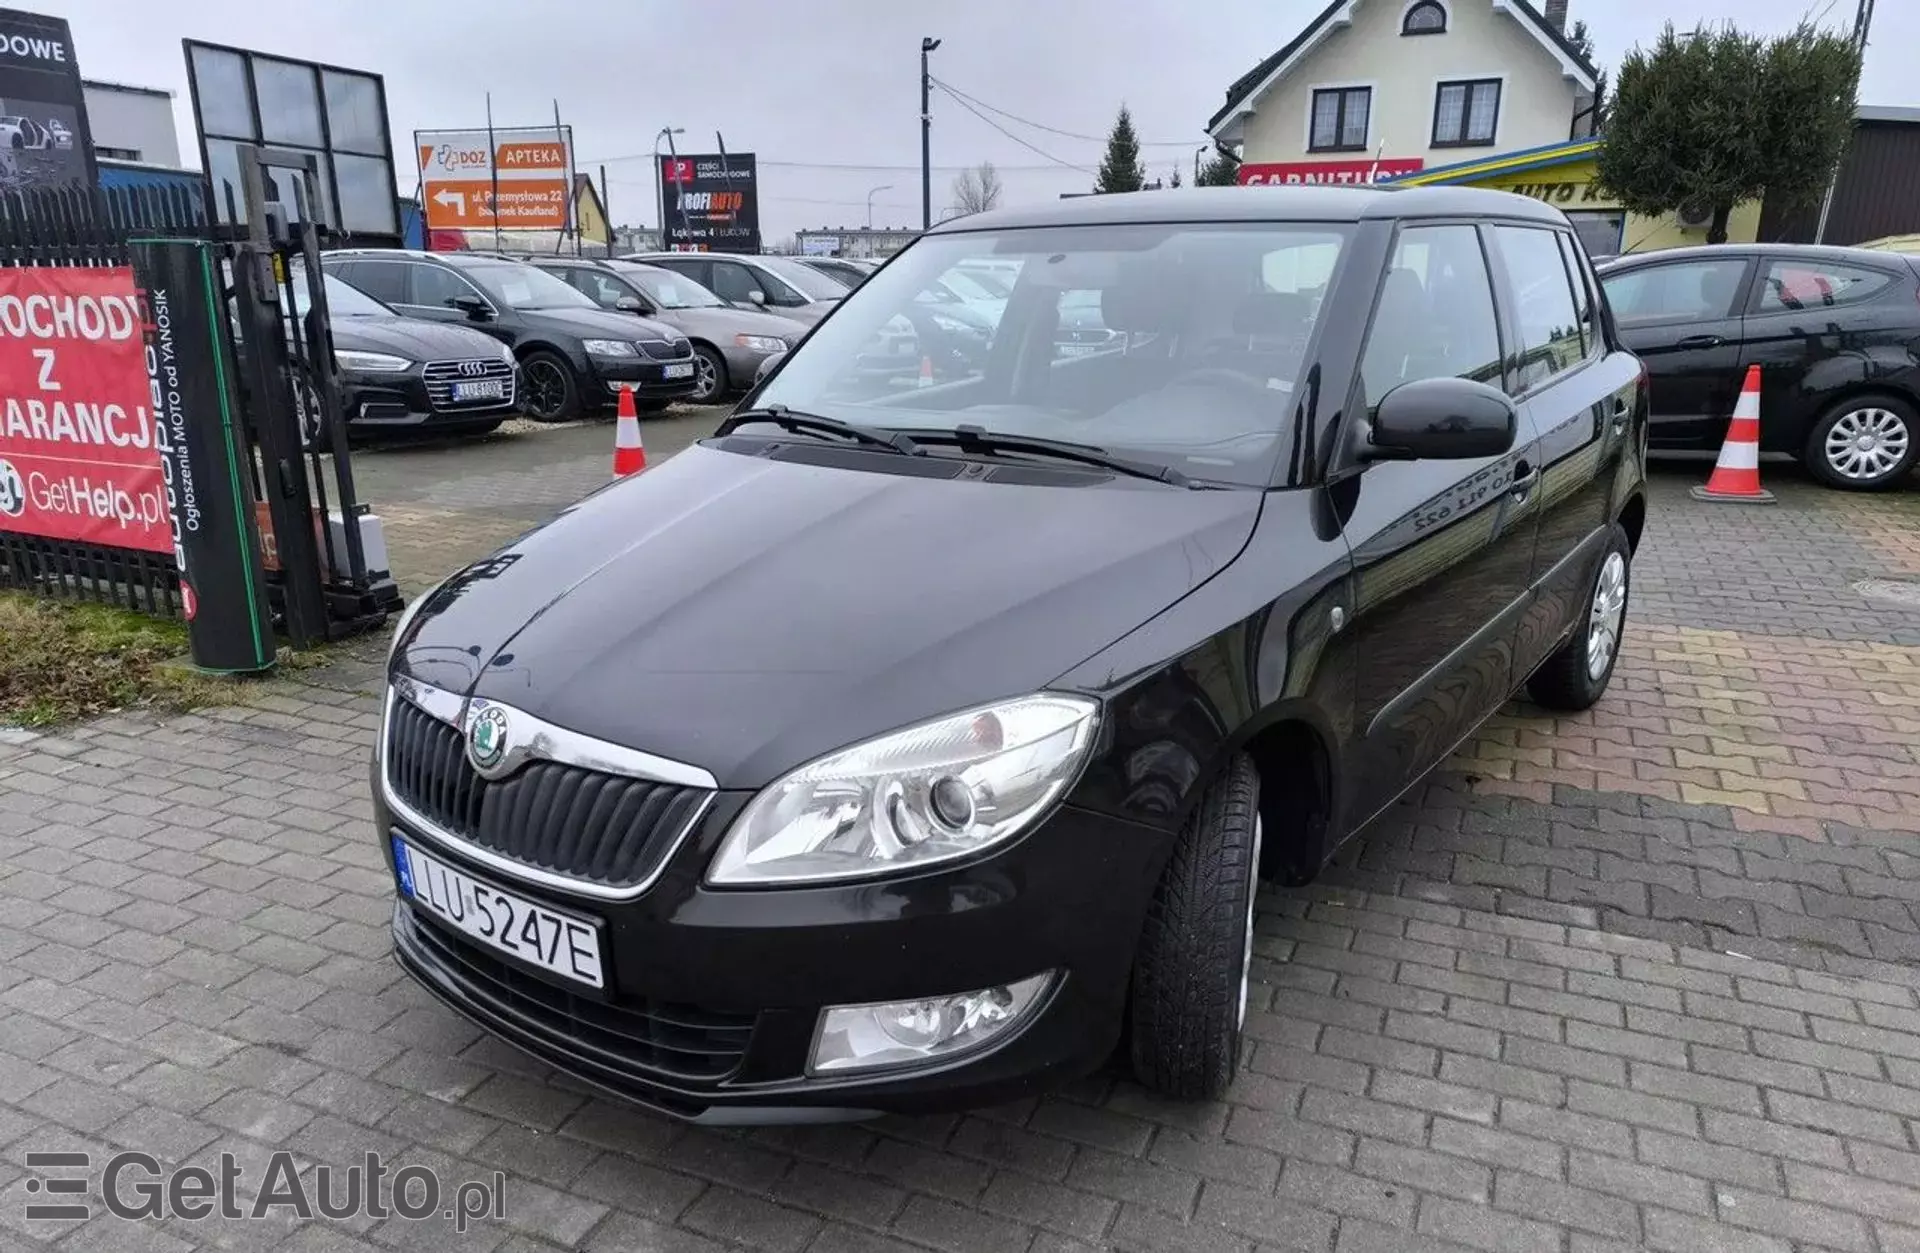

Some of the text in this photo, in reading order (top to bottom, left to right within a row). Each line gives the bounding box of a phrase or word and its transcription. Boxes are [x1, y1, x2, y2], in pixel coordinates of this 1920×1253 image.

[460, 151, 487, 164] DOZ
[506, 149, 561, 164] APTEKA
[485, 189, 549, 203] Pzemysłowa
[550, 189, 562, 202] 22
[0, 294, 140, 341] OCHOD
[32, 348, 61, 391] Z
[0, 398, 150, 449] ARANCJ
[153, 288, 201, 531] Ogłoszenia MOTO od YANOSIK
[28, 471, 166, 532] GetHelp.pl
[407, 848, 598, 982] LLU 5247E
